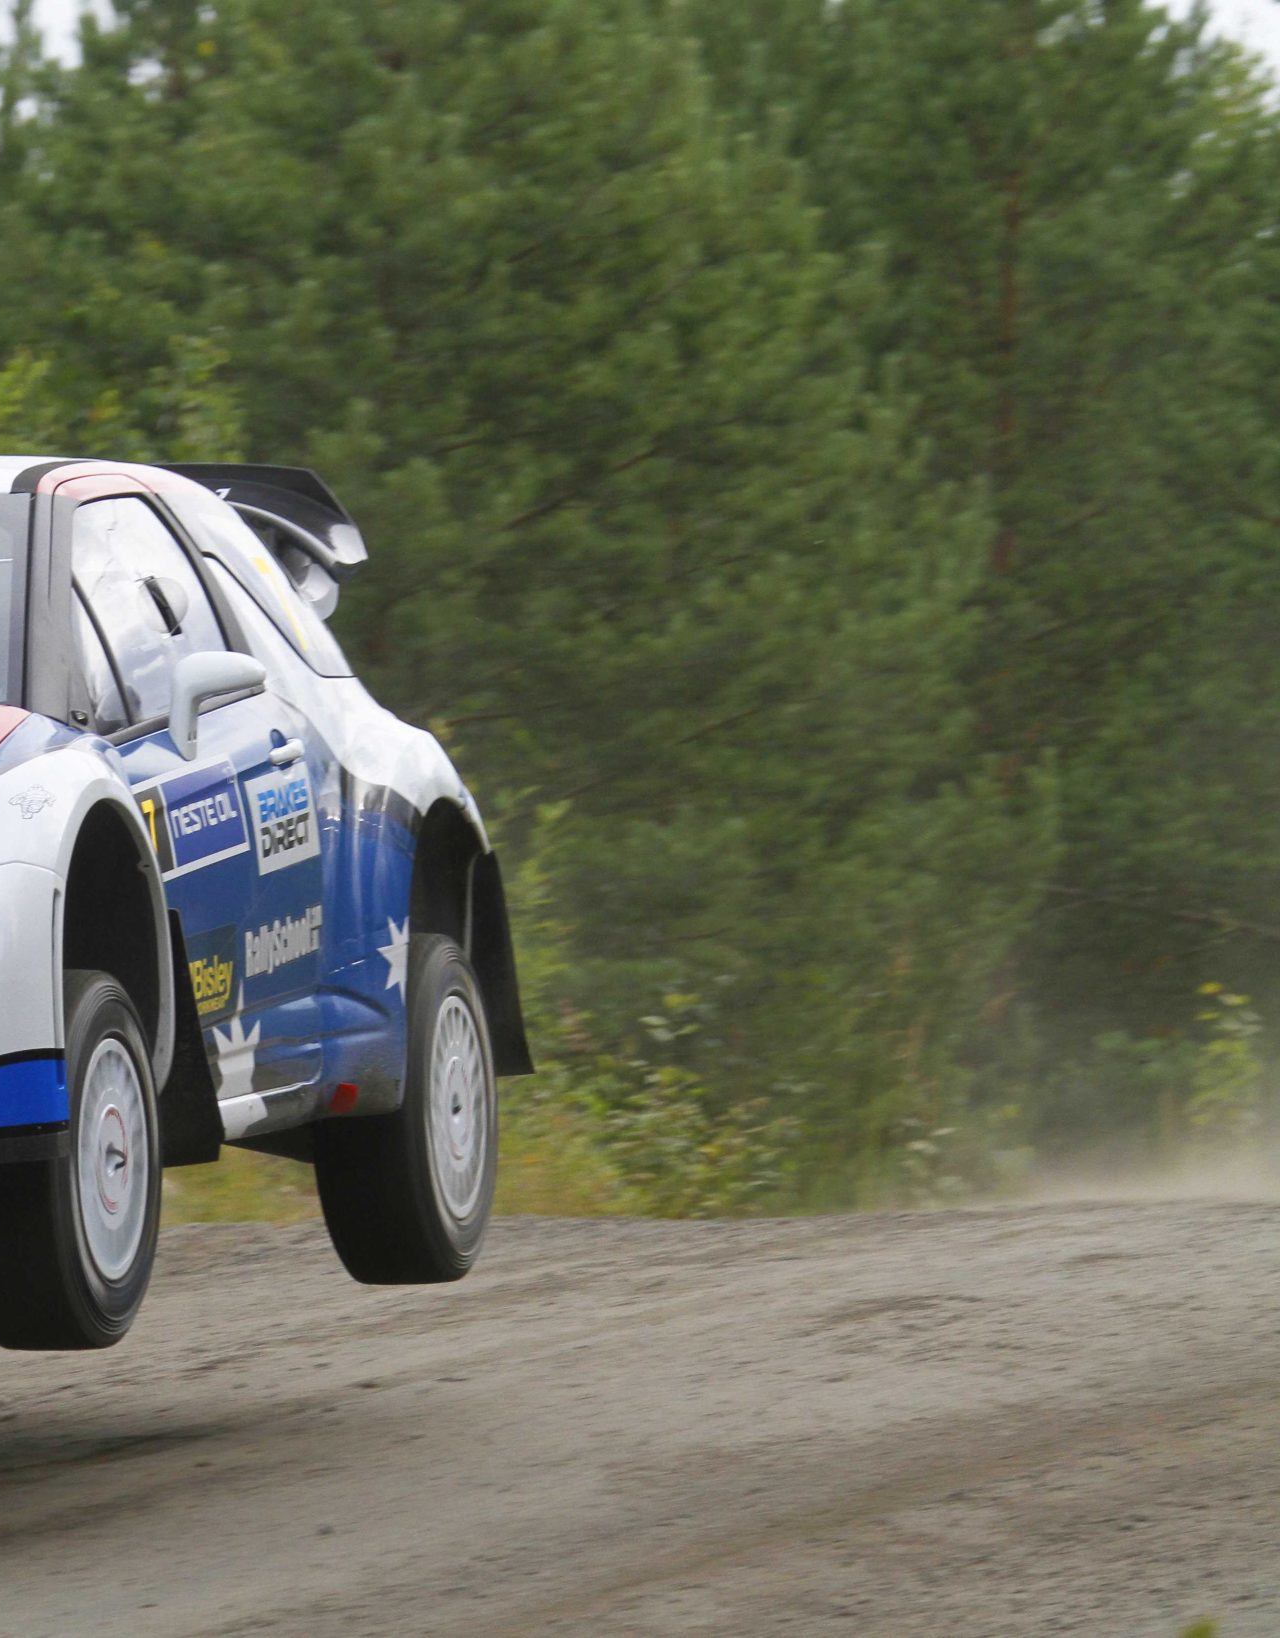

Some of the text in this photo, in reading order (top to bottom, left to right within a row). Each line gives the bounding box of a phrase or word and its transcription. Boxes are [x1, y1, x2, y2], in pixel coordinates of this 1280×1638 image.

[257, 778, 309, 823] BRAKES
[141, 799, 159, 855] 7
[261, 811, 310, 858] DIRECT
[189, 955, 233, 1001] Bisley
